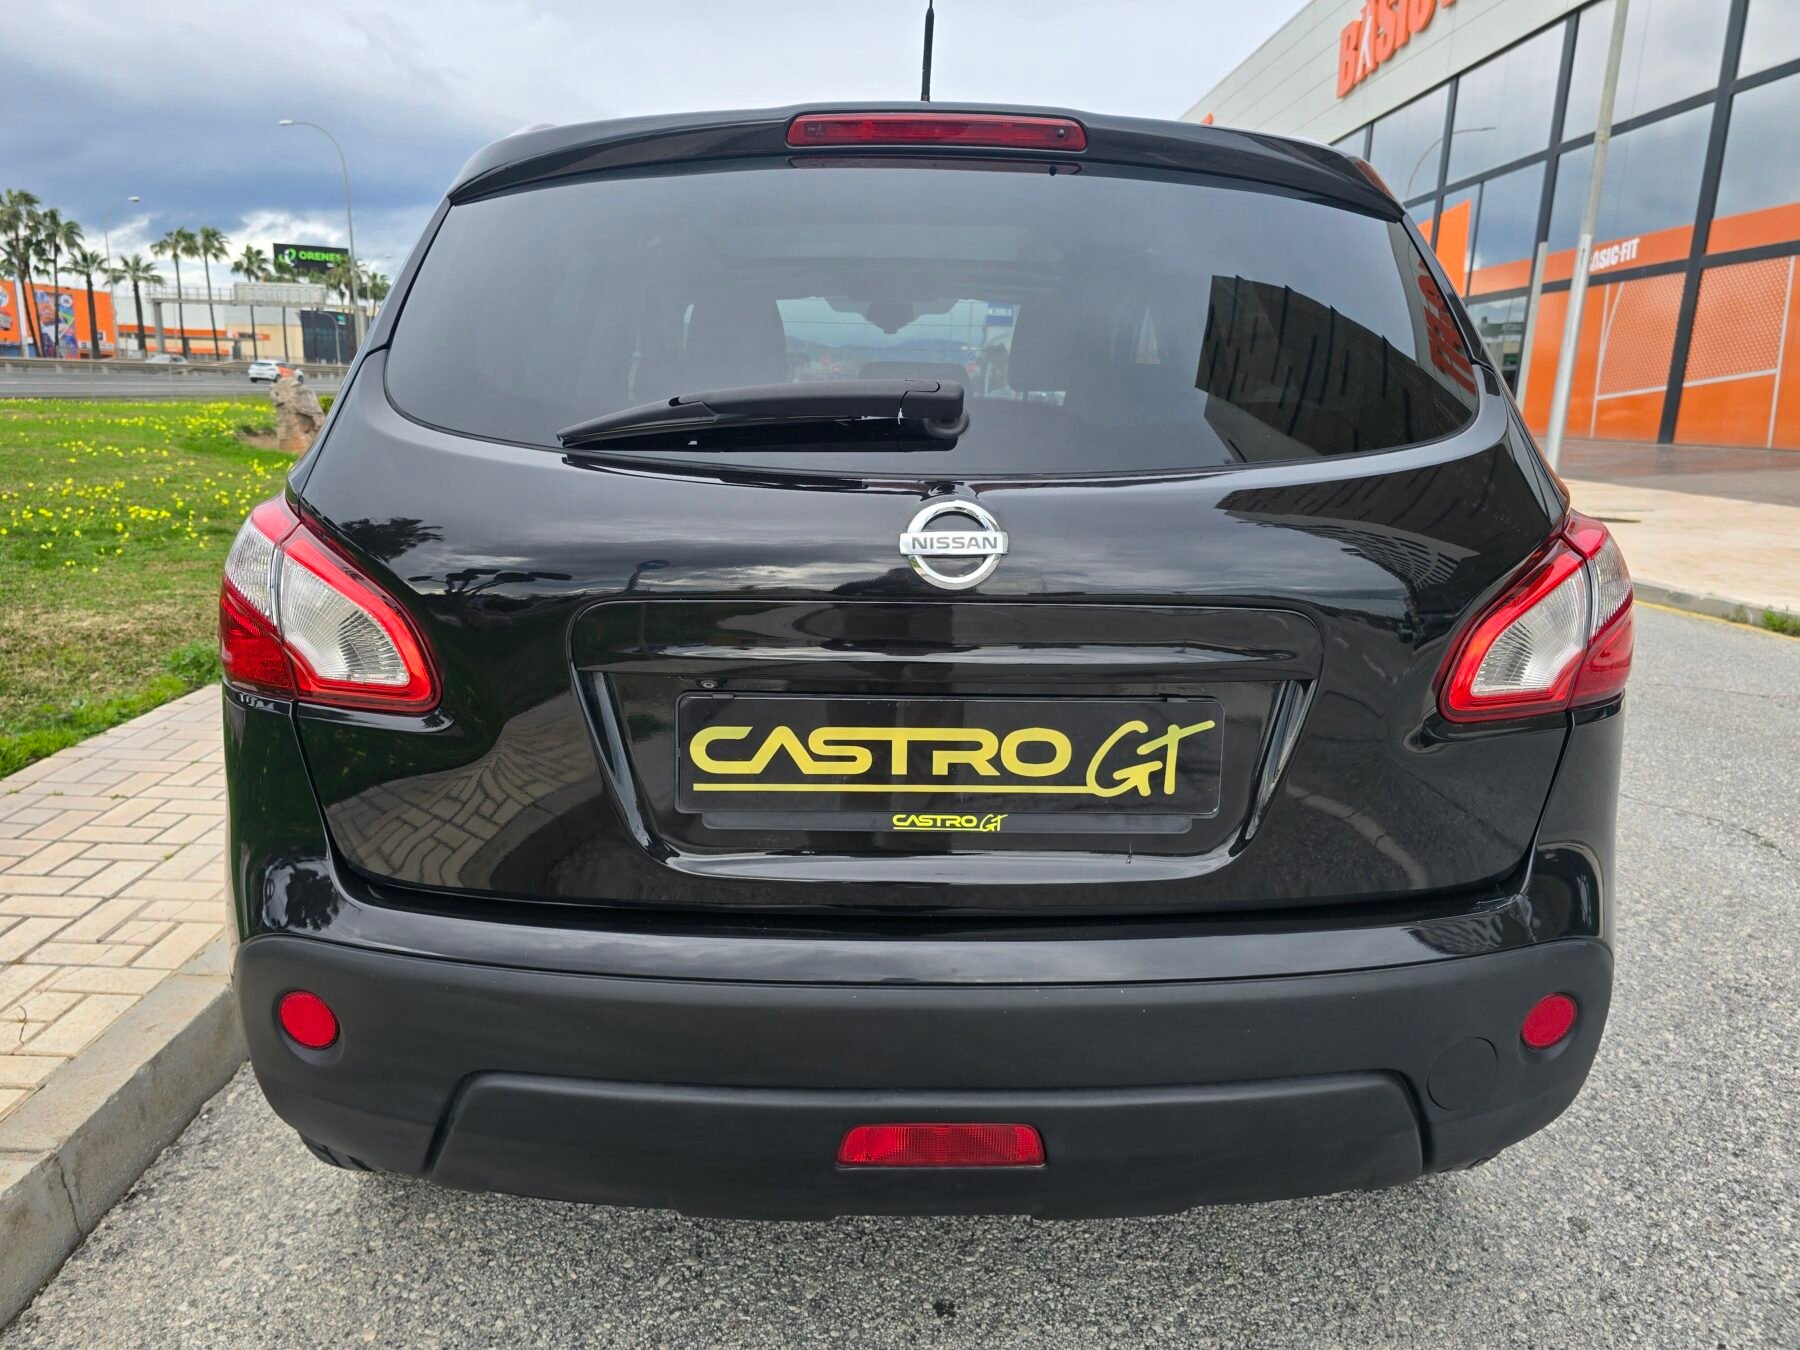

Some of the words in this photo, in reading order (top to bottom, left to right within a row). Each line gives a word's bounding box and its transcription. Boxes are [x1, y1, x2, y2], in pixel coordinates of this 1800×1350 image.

[911, 535, 998, 550] NISSAN
[690, 726, 1072, 777] CASTRO
[1086, 720, 1216, 797] GT
[892, 814, 978, 828] CASTRO
[980, 814, 1008, 832] GT
